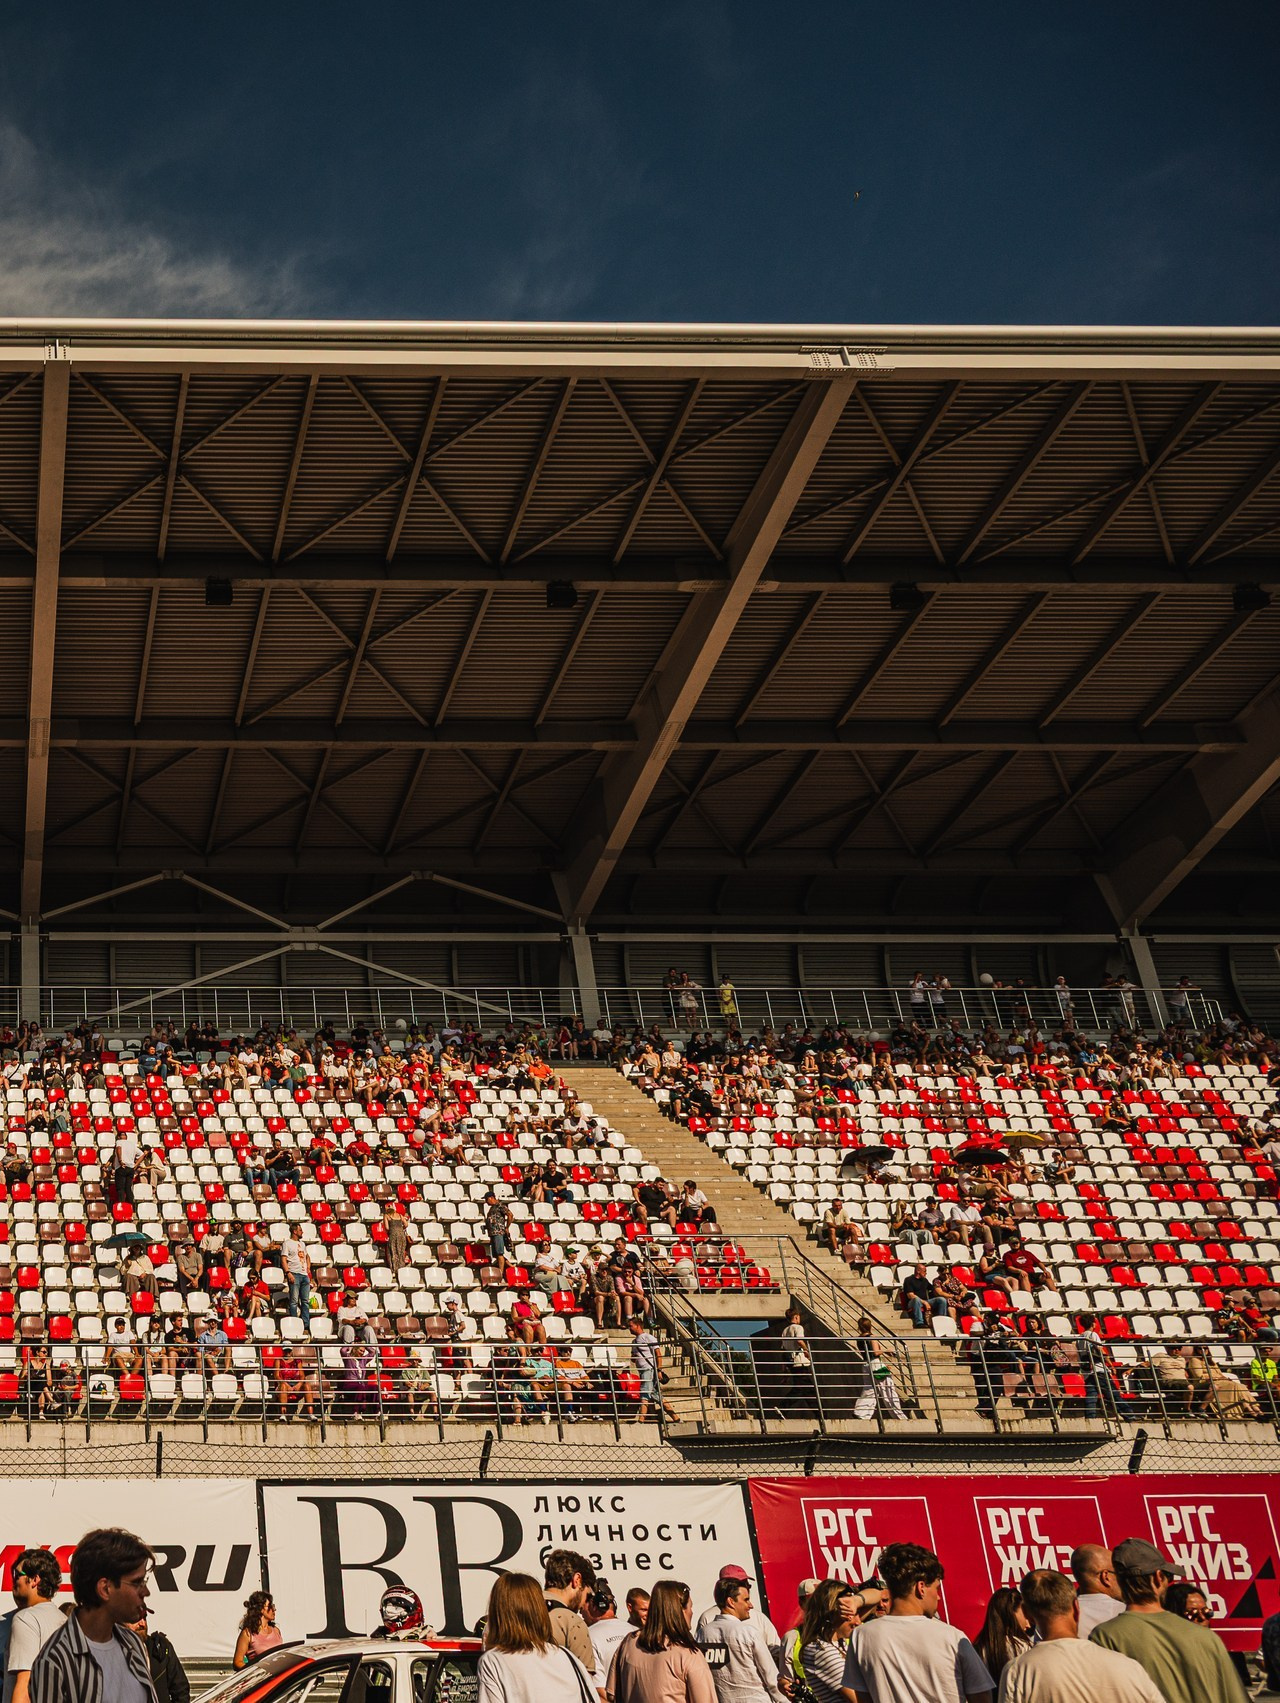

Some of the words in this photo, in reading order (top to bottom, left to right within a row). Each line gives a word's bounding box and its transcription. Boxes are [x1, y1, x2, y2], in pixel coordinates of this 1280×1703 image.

[534, 1495, 626, 1513] люкс
[537, 1523, 718, 1542] личности
[813, 1508, 878, 1545] РГС
[986, 1507, 1051, 1544] РГС
[1156, 1505, 1222, 1542] РГС
[539, 1545, 675, 1570] бзнес
[1165, 1543, 1253, 1581] ЖИЗ
